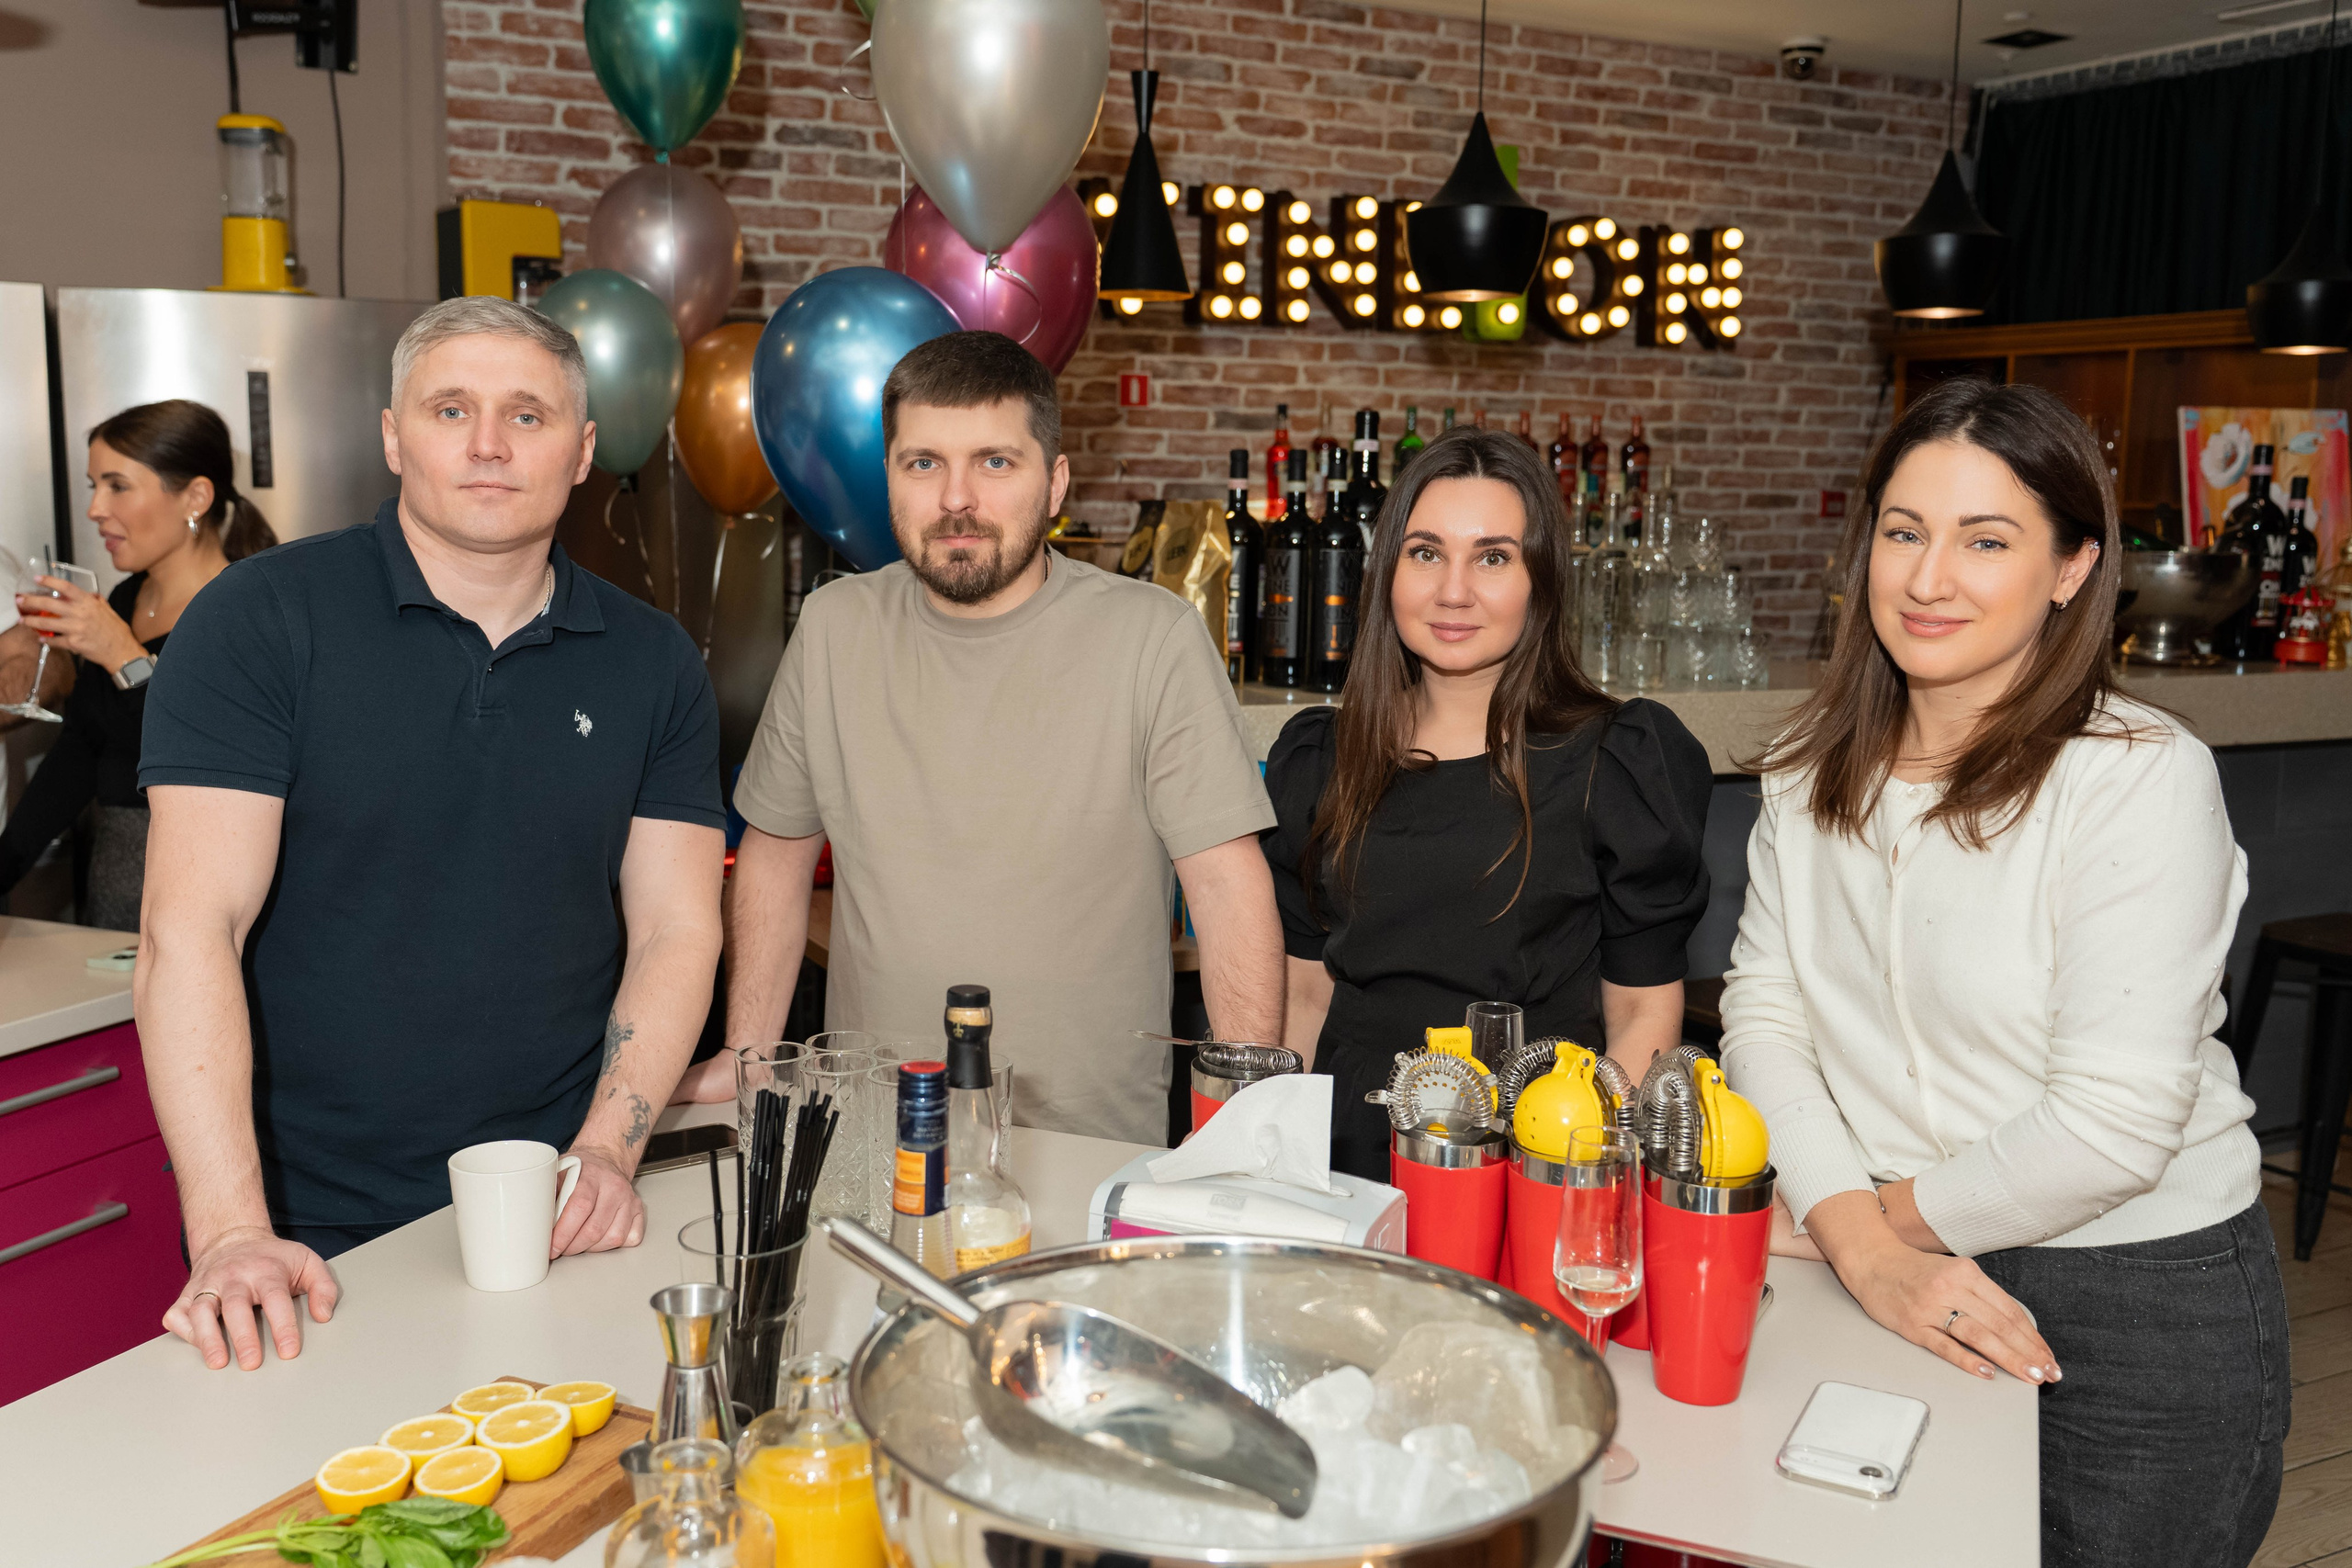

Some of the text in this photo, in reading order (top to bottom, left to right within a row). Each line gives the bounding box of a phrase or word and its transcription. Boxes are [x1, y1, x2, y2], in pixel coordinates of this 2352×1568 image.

[1079, 178, 1743, 349] IN ON
[1212, 1195, 1244, 1210] TORK
